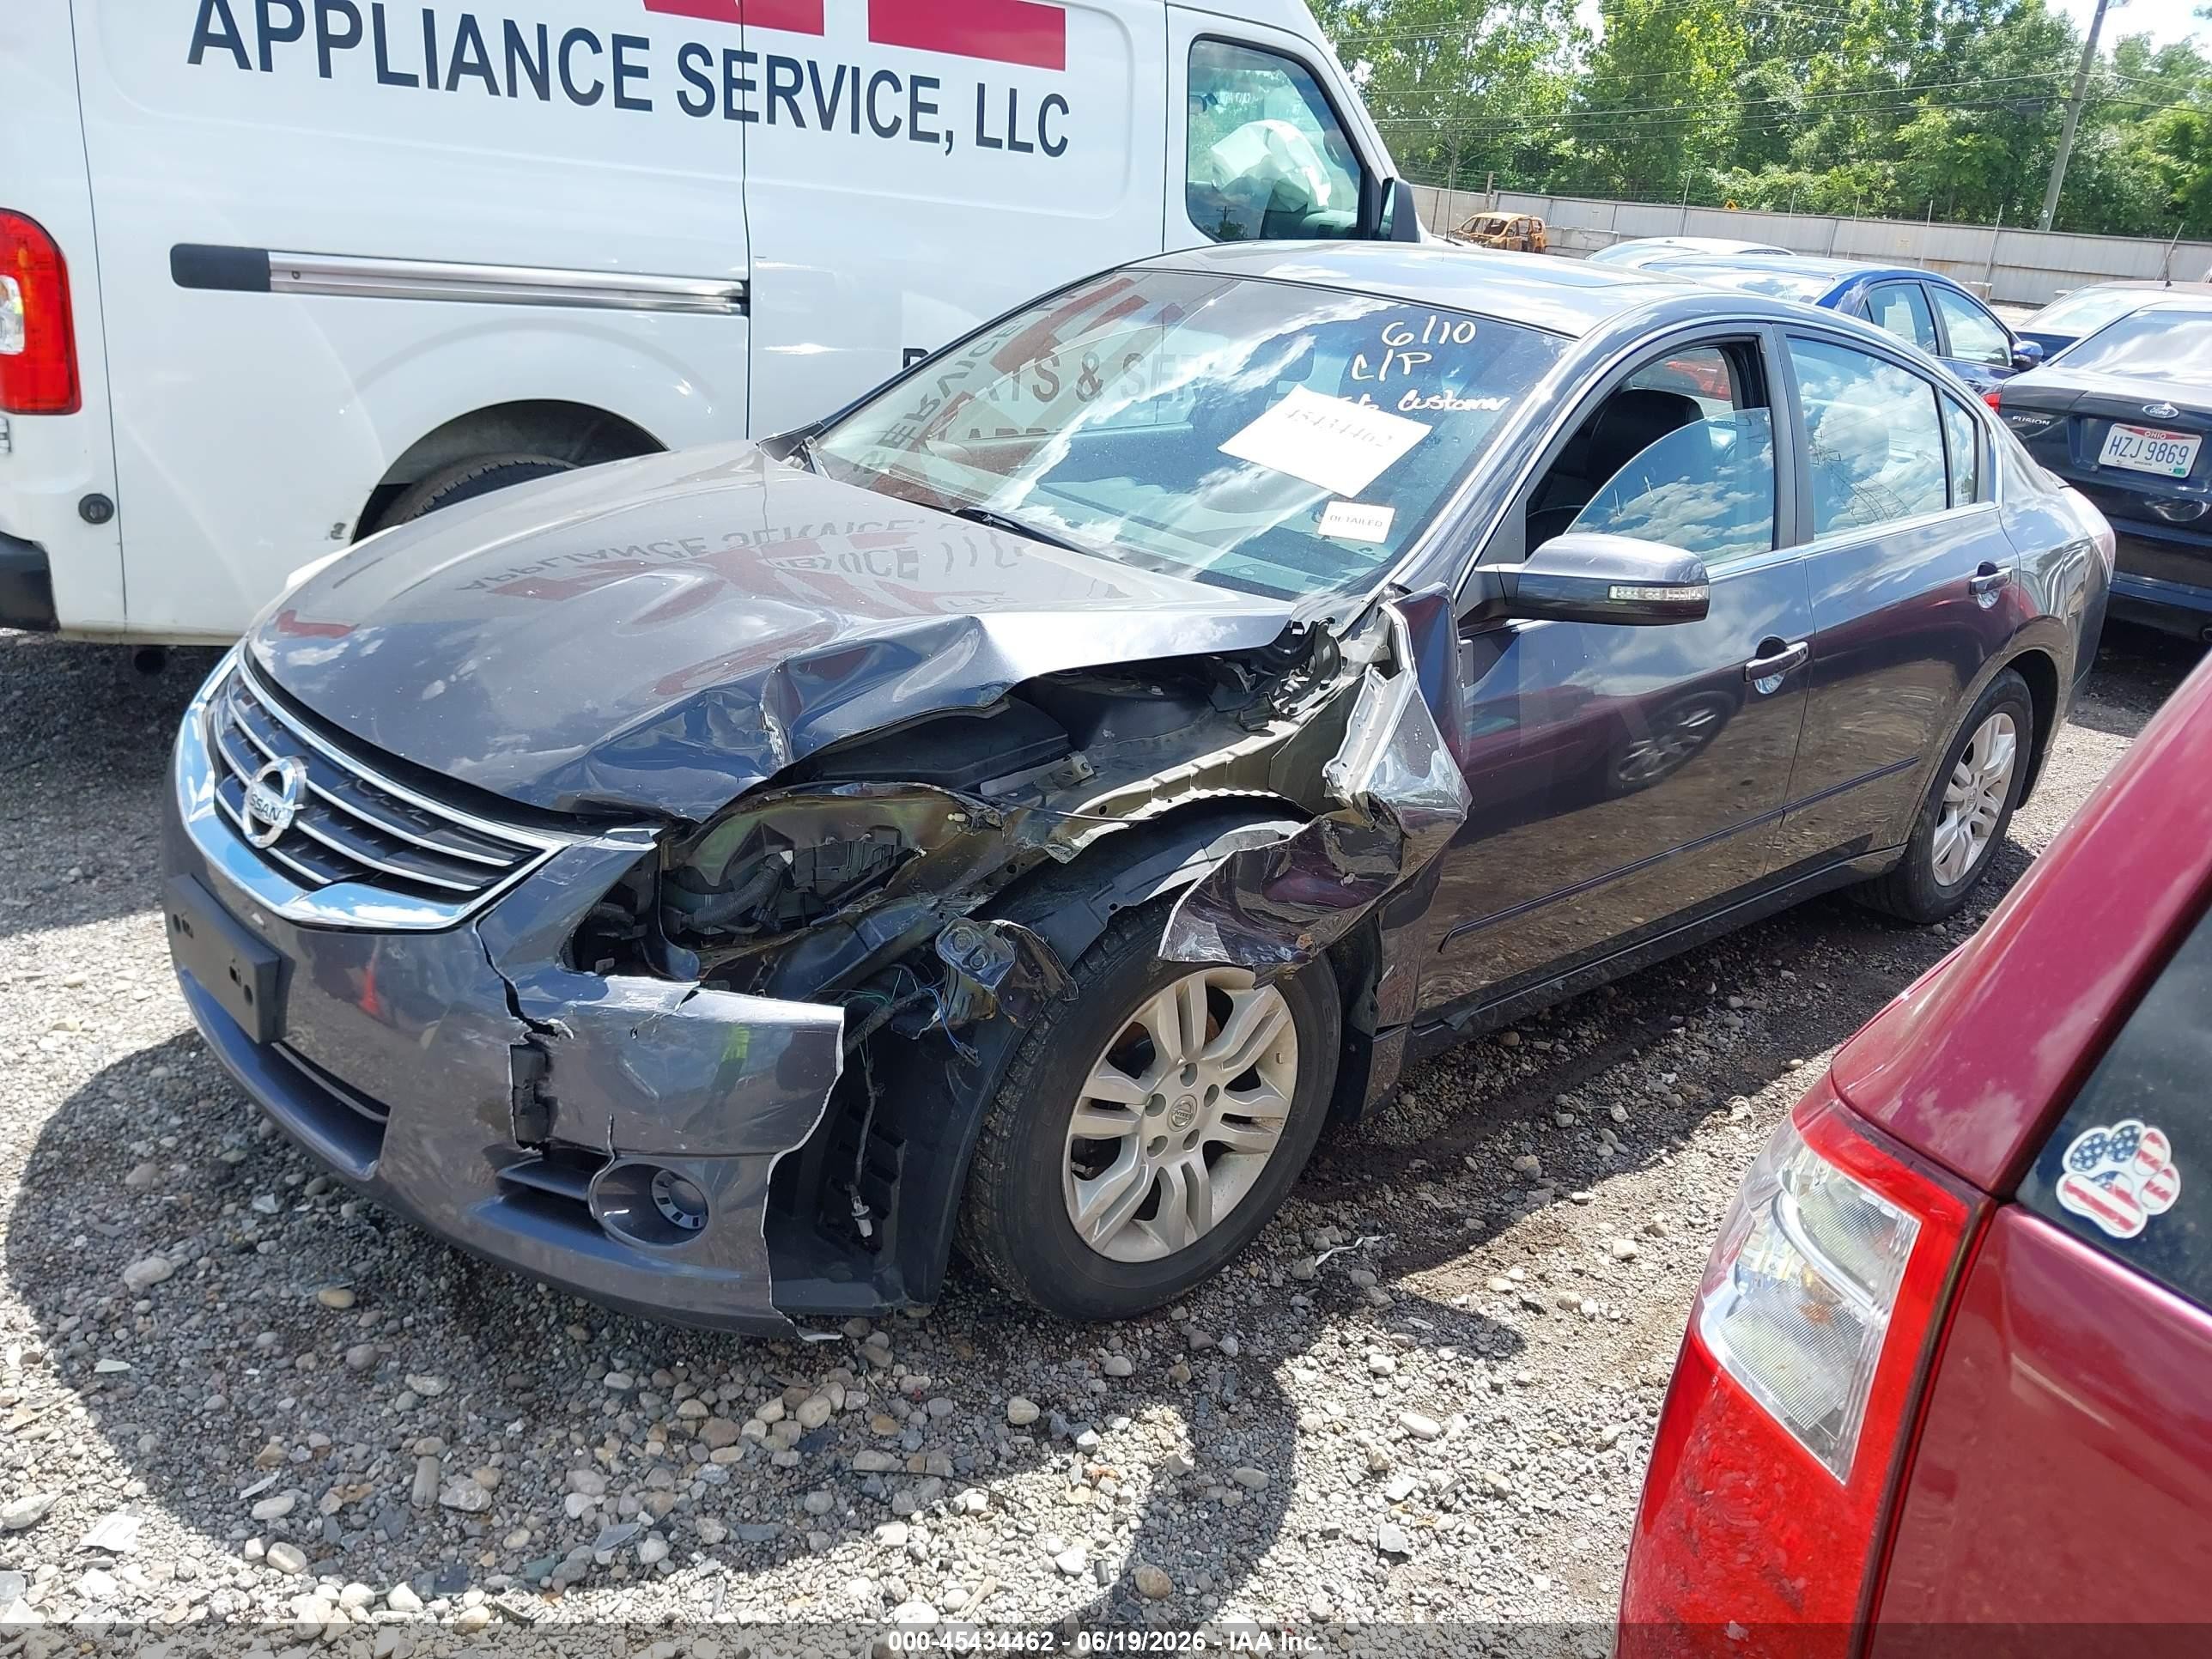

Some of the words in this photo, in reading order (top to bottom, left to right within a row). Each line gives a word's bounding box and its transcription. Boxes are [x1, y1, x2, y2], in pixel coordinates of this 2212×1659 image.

[187, 0, 653, 112] APPLIANCE
[677, 42, 953, 156] SERVICE,
[975, 82, 1069, 157] LLC
[2012, 416, 2051, 426] FUSION
[2144, 431, 2166, 440] OHIO
[2108, 435, 2143, 459] HZJ
[2145, 441, 2189, 465] 9869
